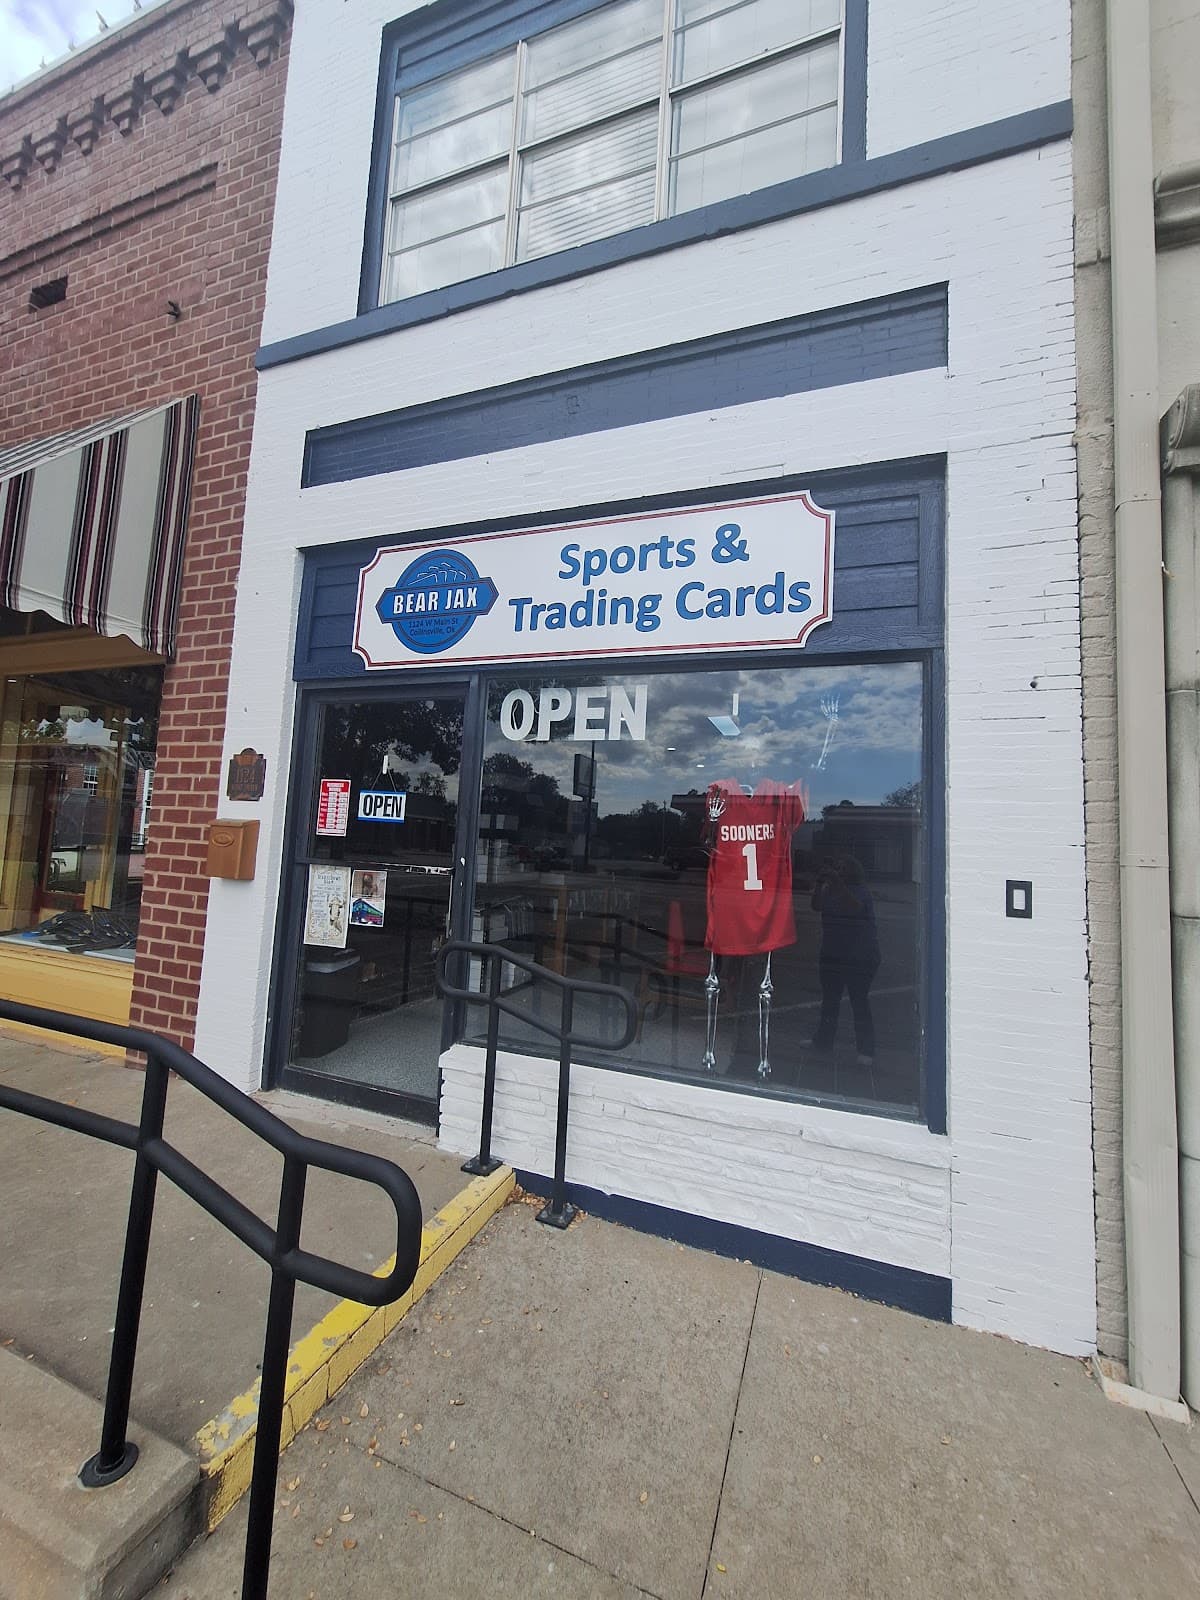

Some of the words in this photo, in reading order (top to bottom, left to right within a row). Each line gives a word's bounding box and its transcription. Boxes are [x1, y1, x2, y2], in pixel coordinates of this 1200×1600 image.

[558, 534, 697, 586] Sports
[710, 523, 750, 565] &
[393, 591, 439, 614] BEAR
[445, 587, 478, 610] JAX
[508, 589, 662, 633] Trading
[675, 571, 812, 620] Cards
[425, 619, 433, 627] W
[451, 617, 458, 625] St
[499, 684, 648, 742] OPEN
[363, 794, 403, 817] OPEN
[721, 823, 775, 842] SOONERS
[742, 843, 763, 891] 1
